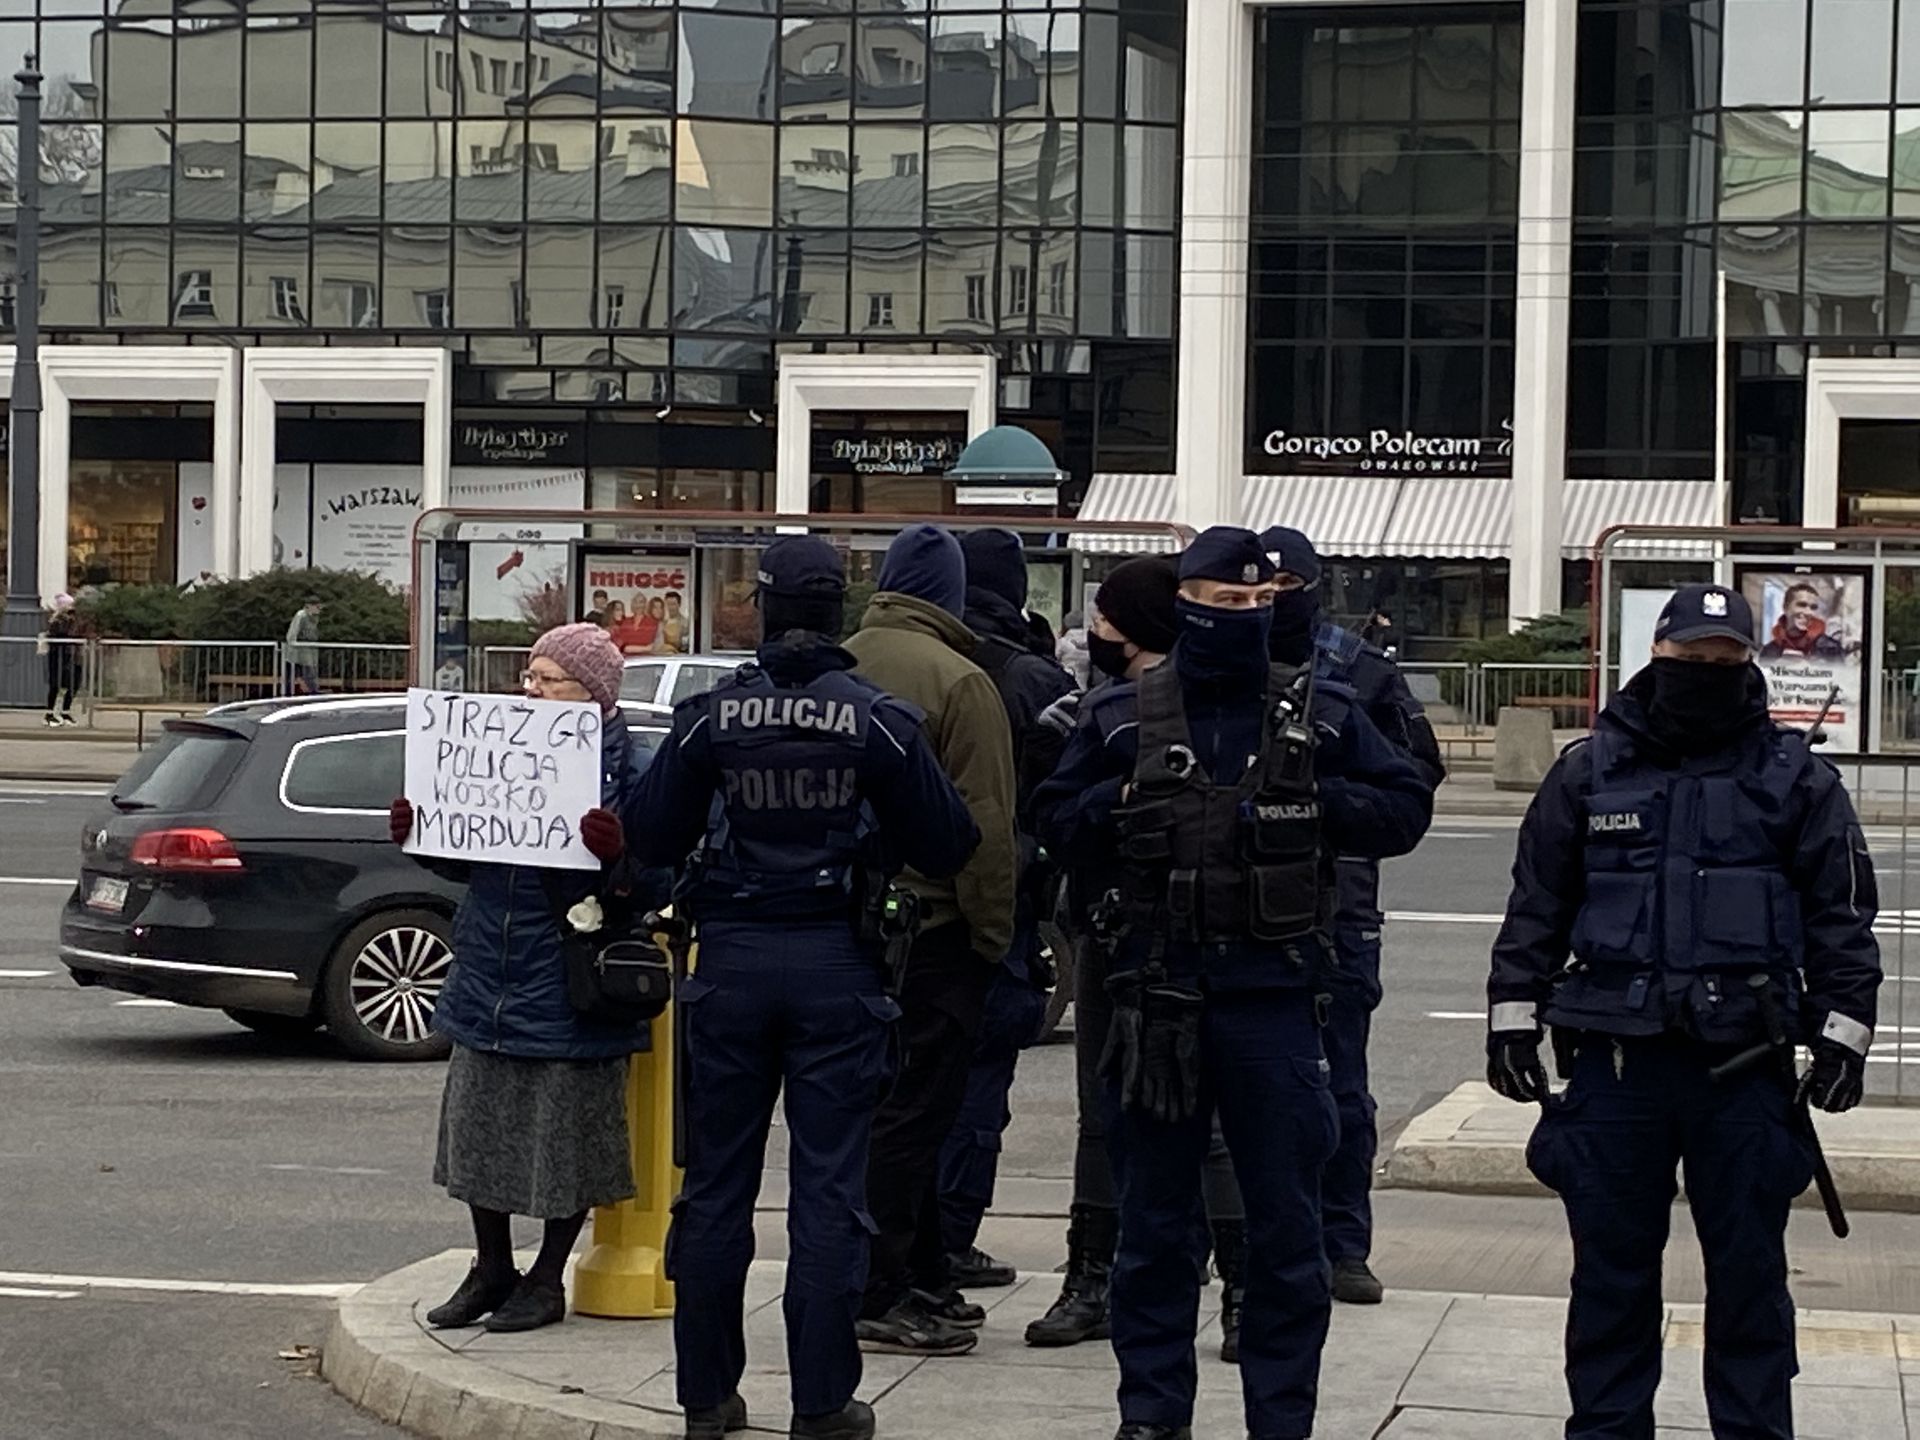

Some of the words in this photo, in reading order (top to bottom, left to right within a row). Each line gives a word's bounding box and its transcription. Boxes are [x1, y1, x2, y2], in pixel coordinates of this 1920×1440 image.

[1264, 430, 1362, 459] Gorąco
[1370, 430, 1481, 455] Polecam
[548, 709, 599, 751] GR
[719, 697, 858, 736] POLICJA
[437, 738, 559, 784] POLICJA
[434, 776, 548, 814] WOJSKO
[721, 767, 856, 811] POLICJA
[1586, 812, 1641, 836] POLICJA
